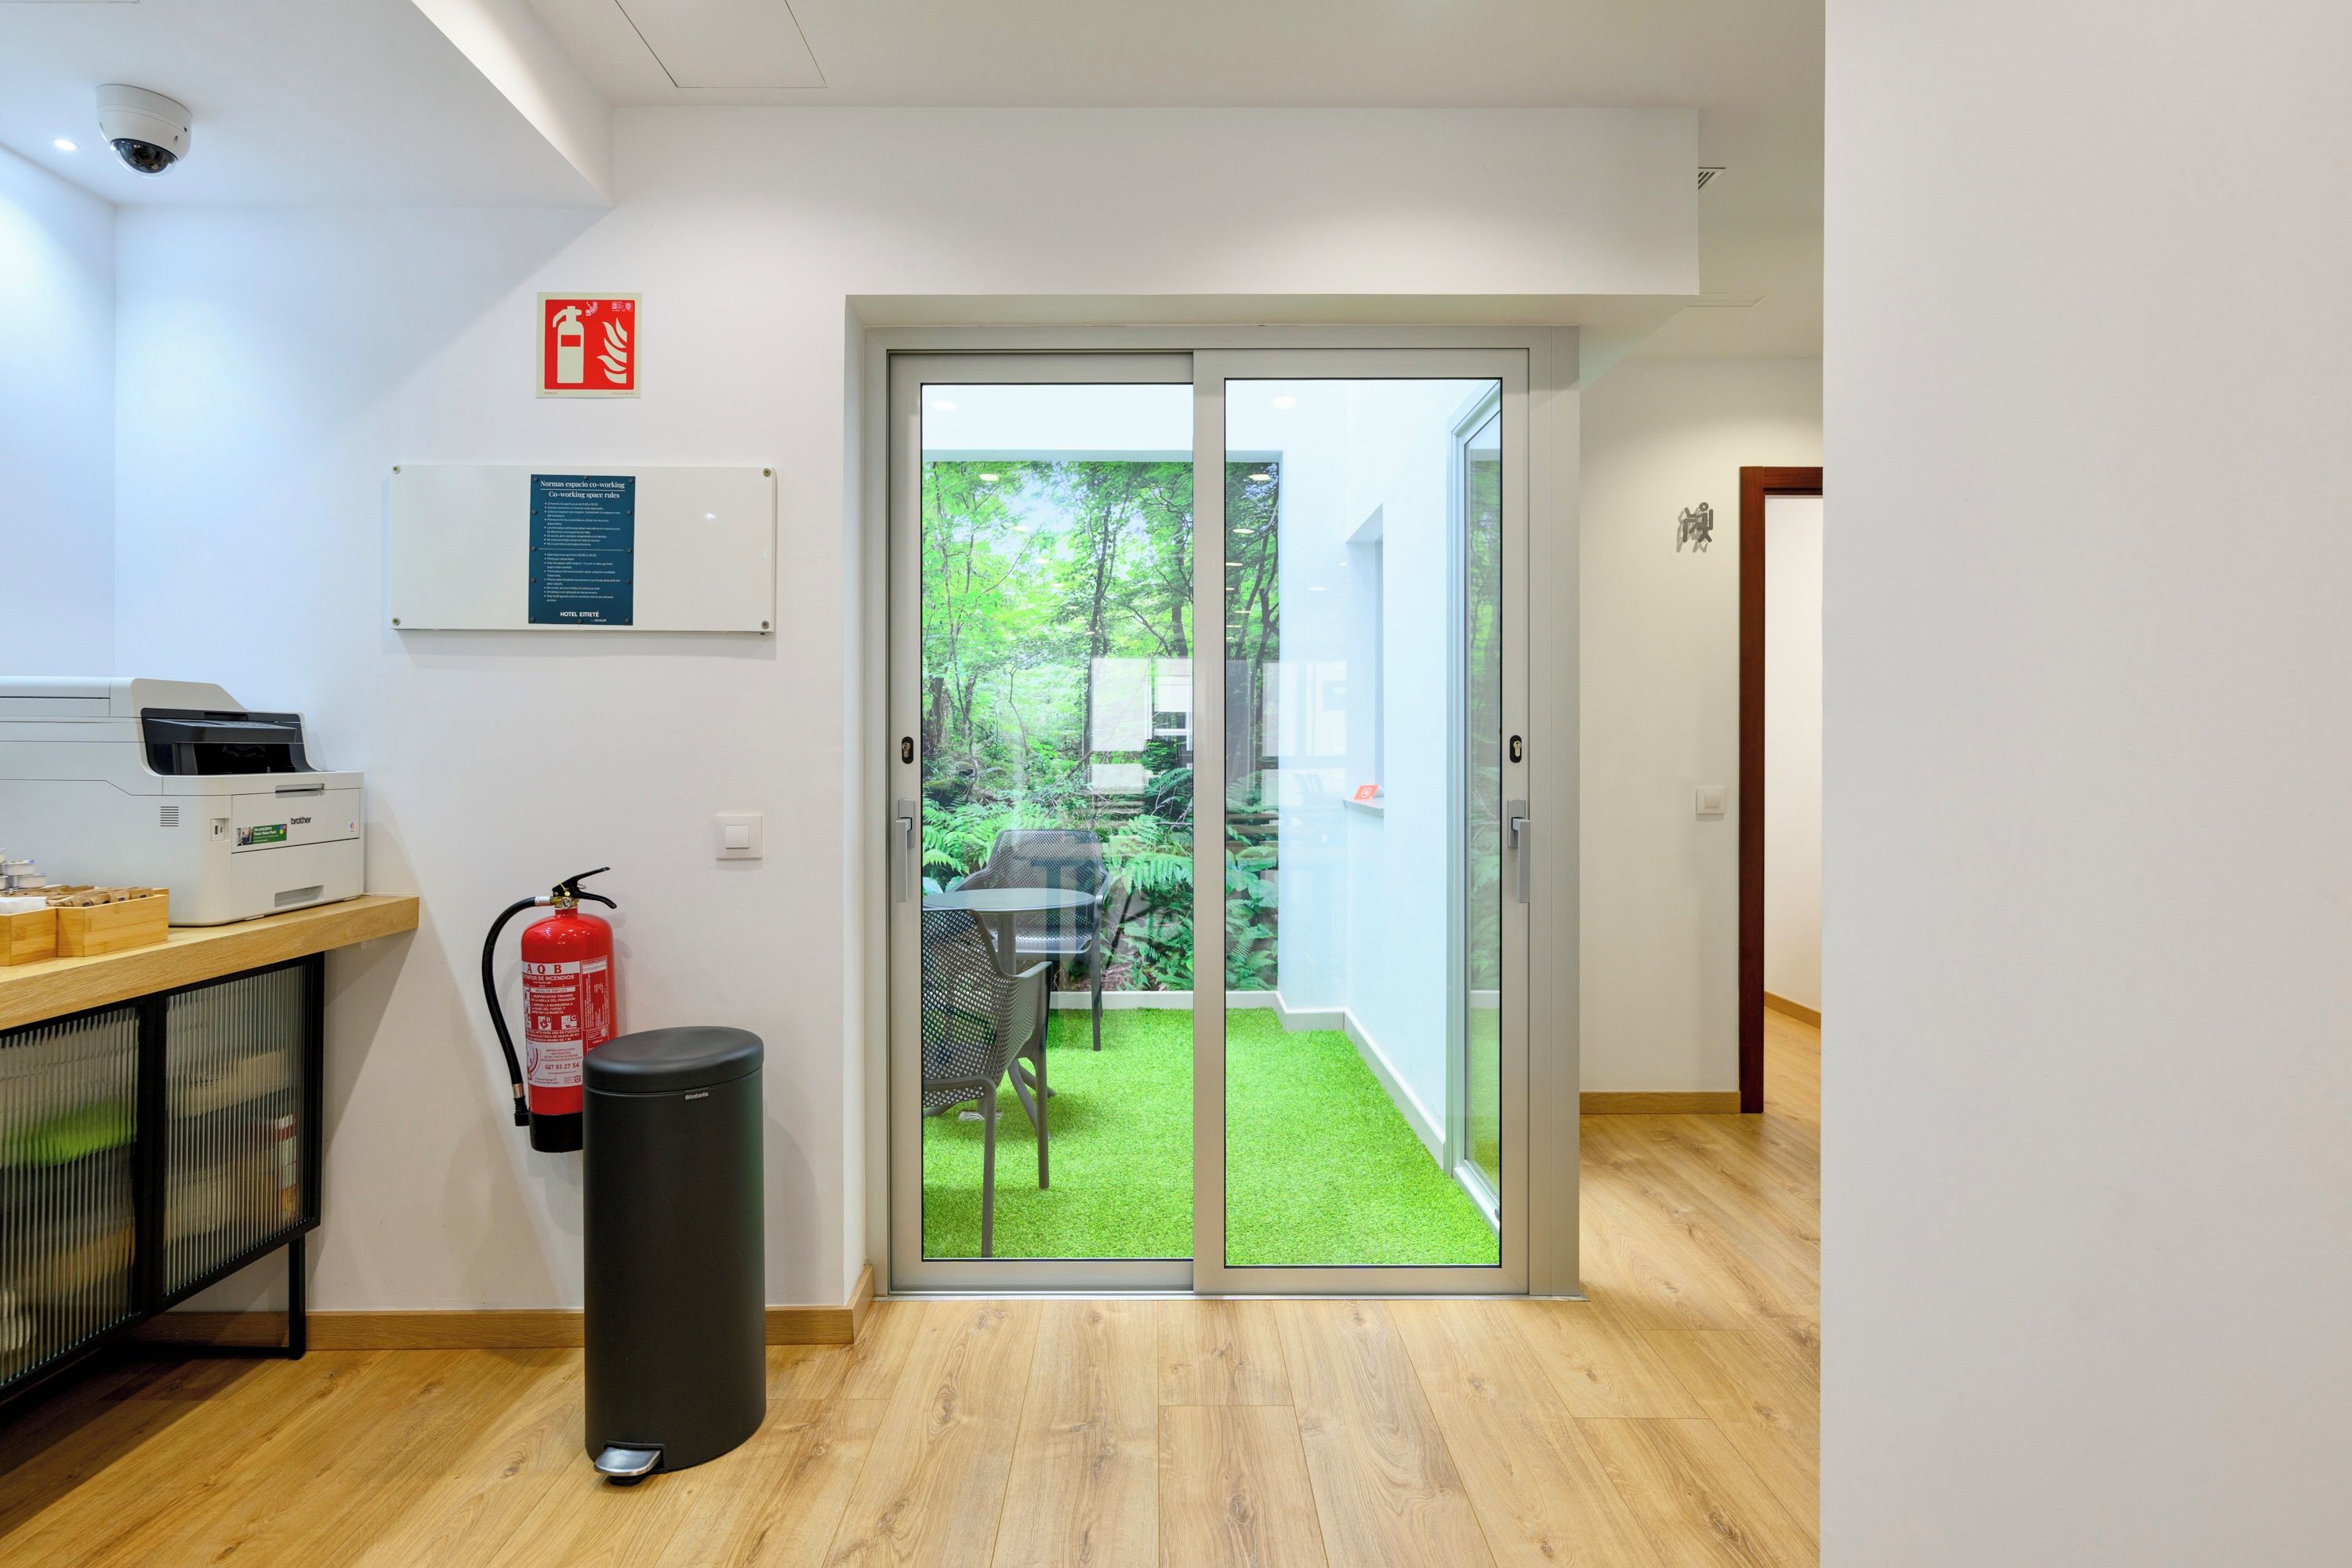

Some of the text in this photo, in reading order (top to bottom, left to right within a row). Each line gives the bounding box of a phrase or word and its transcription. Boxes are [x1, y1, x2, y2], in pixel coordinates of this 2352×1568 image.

[291, 816, 311, 825] brother
[527, 964, 562, 974] A Q B
